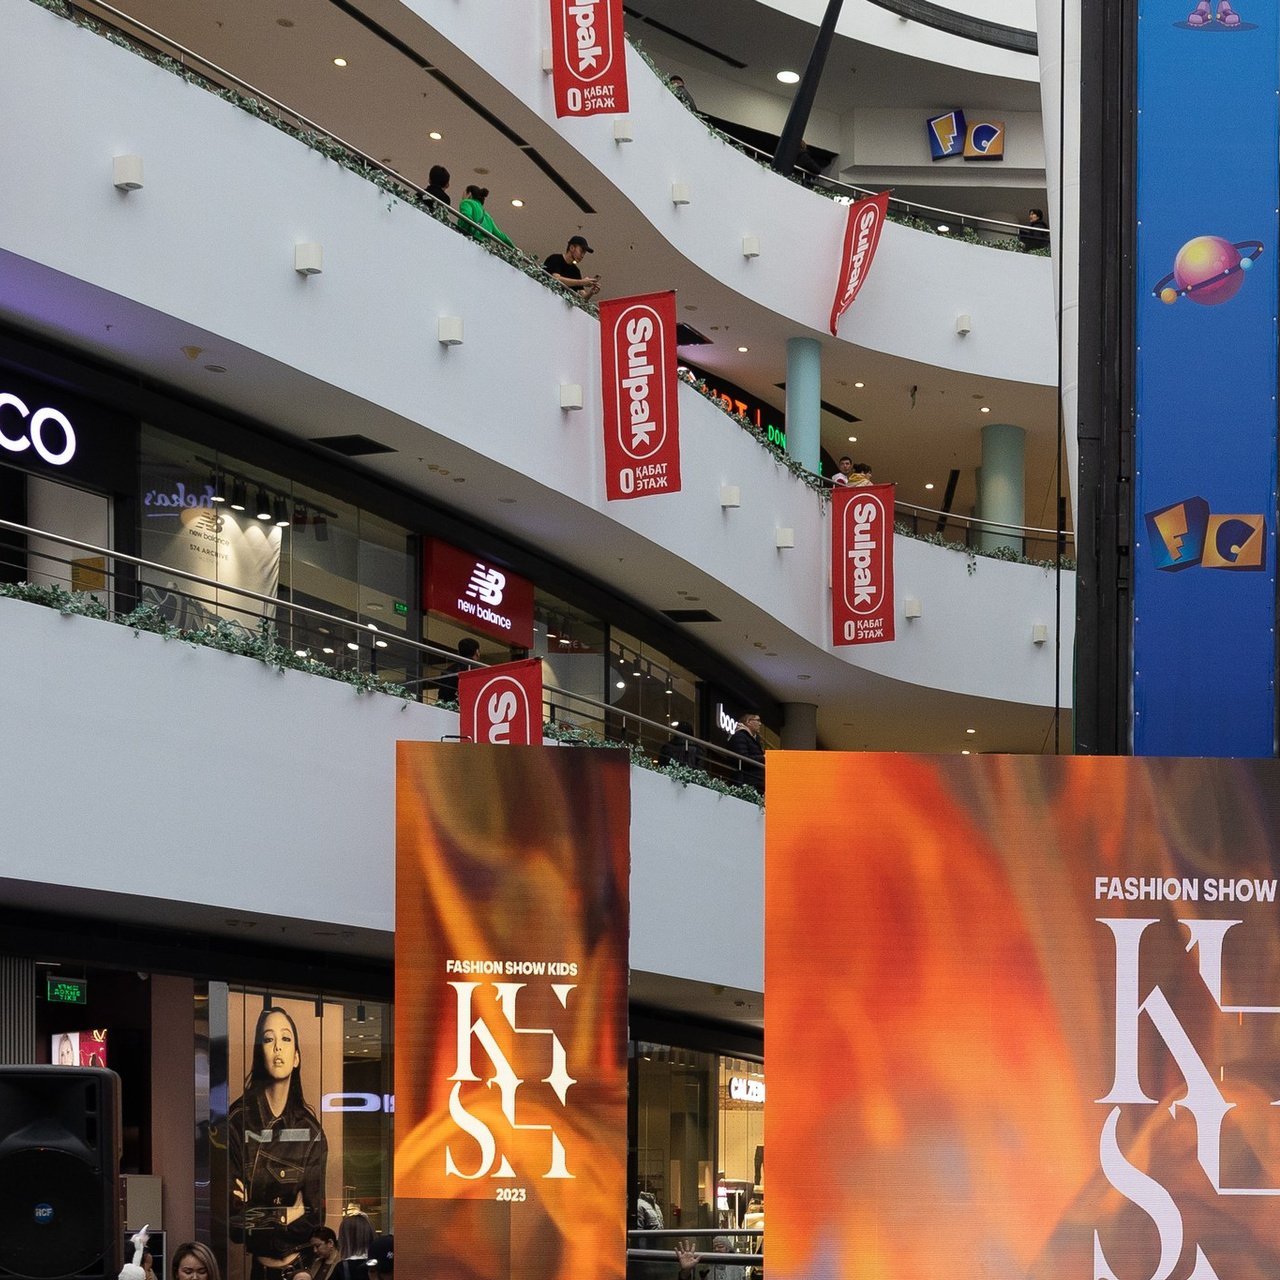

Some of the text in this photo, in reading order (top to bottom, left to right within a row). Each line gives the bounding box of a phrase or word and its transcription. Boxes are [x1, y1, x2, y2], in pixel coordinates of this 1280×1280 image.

[567, 85, 615, 111] 0 ҚАБАТ
[585, 98, 615, 111] ЭТАЖ
[845, 210, 875, 300] Sulpak
[622, 317, 656, 450] Sulpak
[619, 463, 667, 493] 0 ҚАБАТ
[636, 476, 668, 491] ЭТАЖ
[848, 502, 877, 606] Sulpak
[457, 598, 511, 630] new balance
[844, 618, 884, 641] 0 ҚАБАТ
[857, 628, 884, 640] ЭТАЖ
[1095, 876, 1199, 901] FASHION
[1203, 879, 1277, 903] SHOW
[446, 960, 578, 976] FASHION SHOW KIDS
[495, 1188, 527, 1202] 2023
[35, 1208, 53, 1217] RCF
